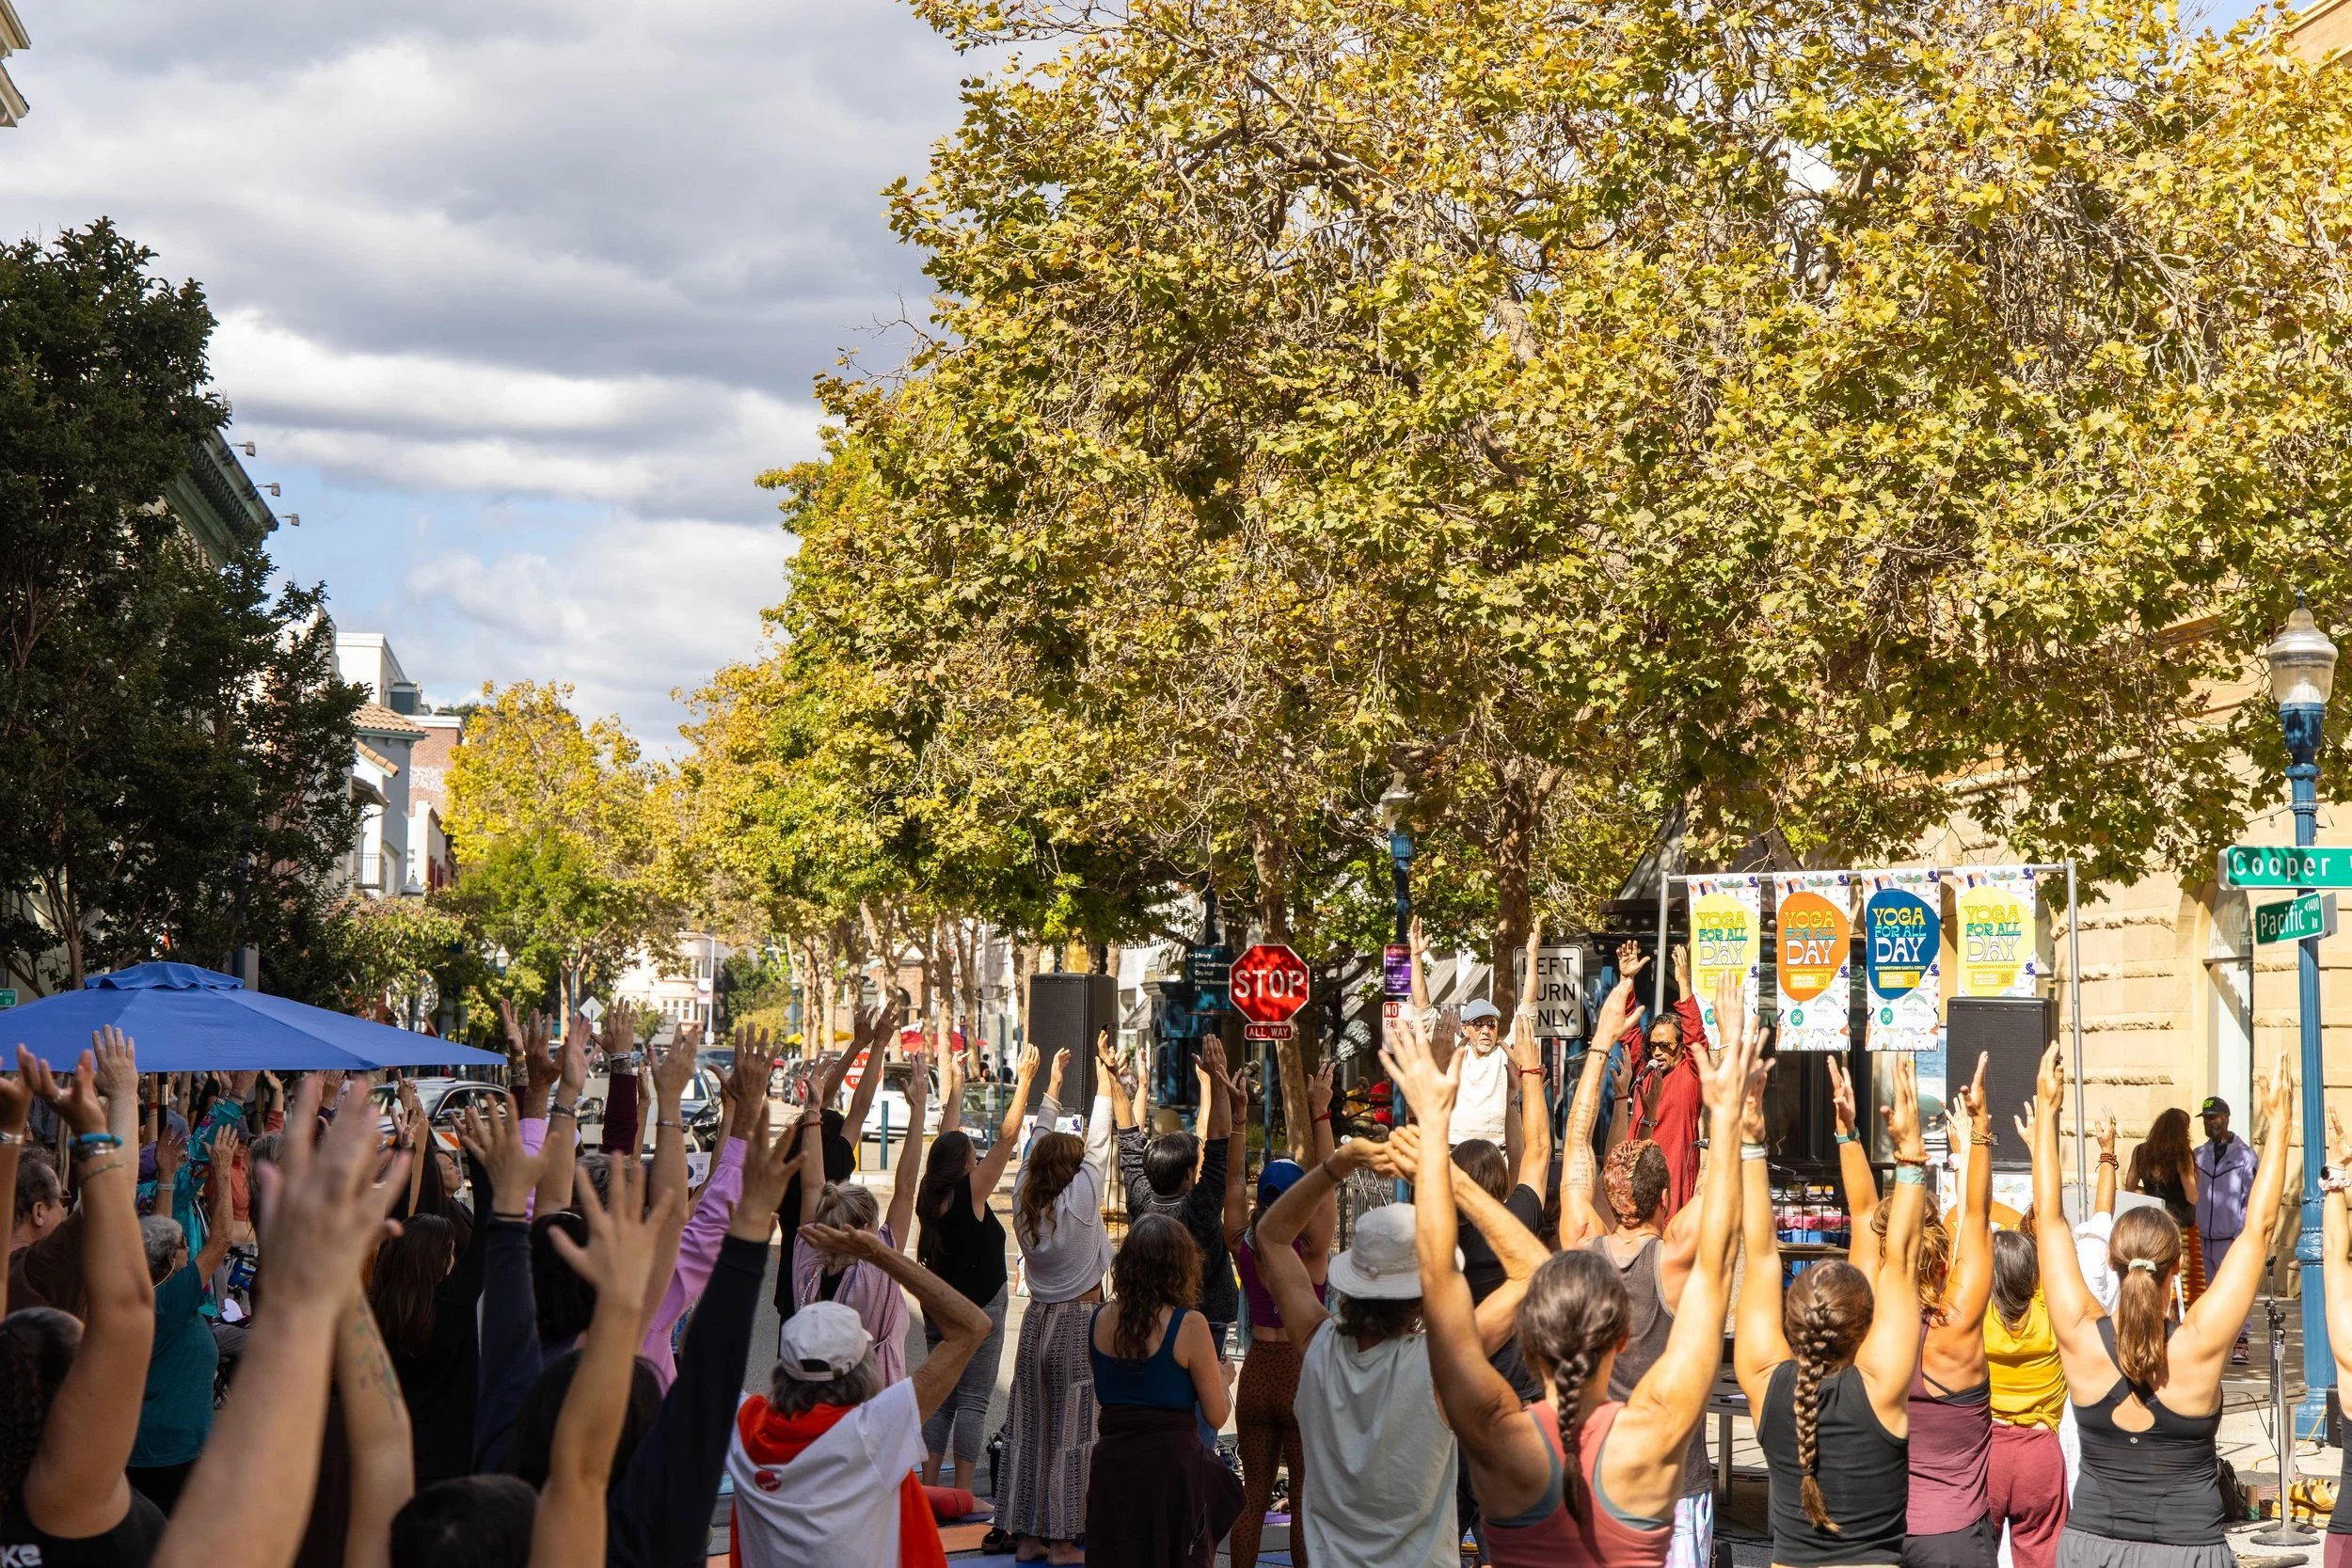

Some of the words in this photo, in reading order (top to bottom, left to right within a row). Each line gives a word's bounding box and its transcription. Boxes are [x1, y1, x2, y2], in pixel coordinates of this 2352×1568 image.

[2233, 850, 2331, 883] Cooper
[1696, 911, 1748, 930] YOGA
[1785, 911, 1836, 928] YOGA
[1872, 907, 1927, 927] YOGA
[1963, 905, 2021, 924] YOGA
[2260, 904, 2305, 938] Pacific
[2309, 897, 2320, 913] 1400
[1698, 928, 1724, 942] FOR
[1727, 927, 1748, 942] ALL
[1785, 927, 1811, 941] FOR
[1814, 927, 1837, 941] ALL
[1874, 926, 1900, 938] FOR
[1903, 926, 1927, 938] ALL
[1966, 923, 1994, 937] FOR
[1996, 922, 2021, 936] ALL
[1699, 941, 1748, 966] DAY
[1786, 940, 1837, 965] DAY
[1875, 937, 1927, 963] DAY
[1966, 935, 2021, 962] DAY
[1234, 970, 1305, 999] STOP
[1521, 984, 1576, 1001] URN
[1385, 1005, 1398, 1016] NO
[1538, 1009, 1574, 1027] NLY
[1249, 1027, 1266, 1037] ALL
[1271, 1027, 1289, 1037] WAY
